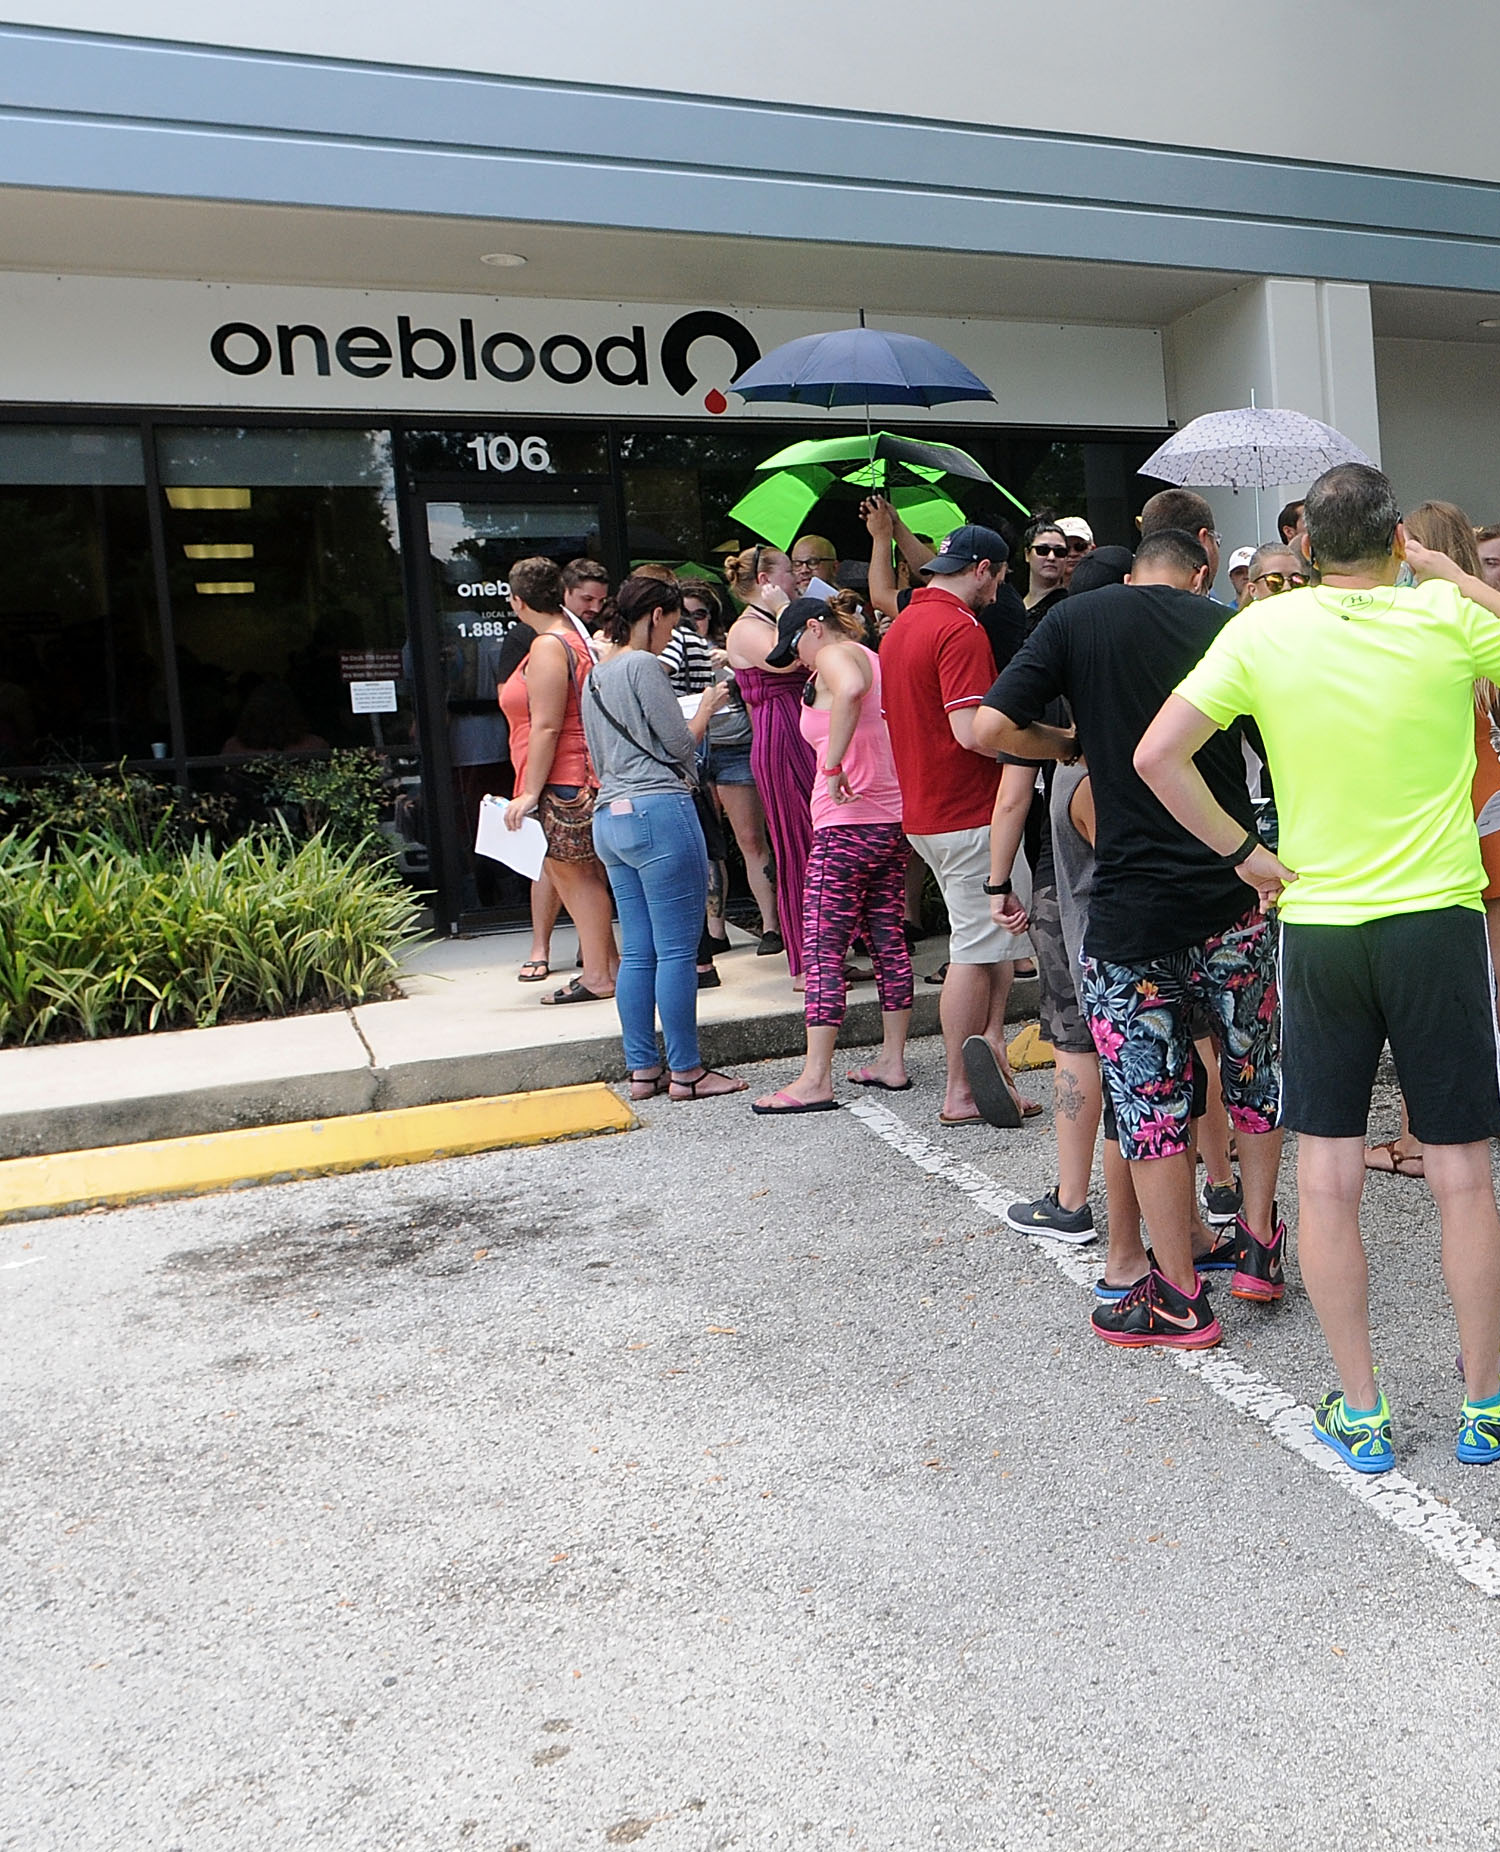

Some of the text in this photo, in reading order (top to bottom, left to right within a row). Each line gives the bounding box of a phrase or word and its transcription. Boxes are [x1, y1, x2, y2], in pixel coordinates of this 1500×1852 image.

[210, 315, 649, 386] oneblood
[466, 435, 551, 472] 106
[457, 579, 512, 597] oneb
[481, 610, 506, 619] LOCAL
